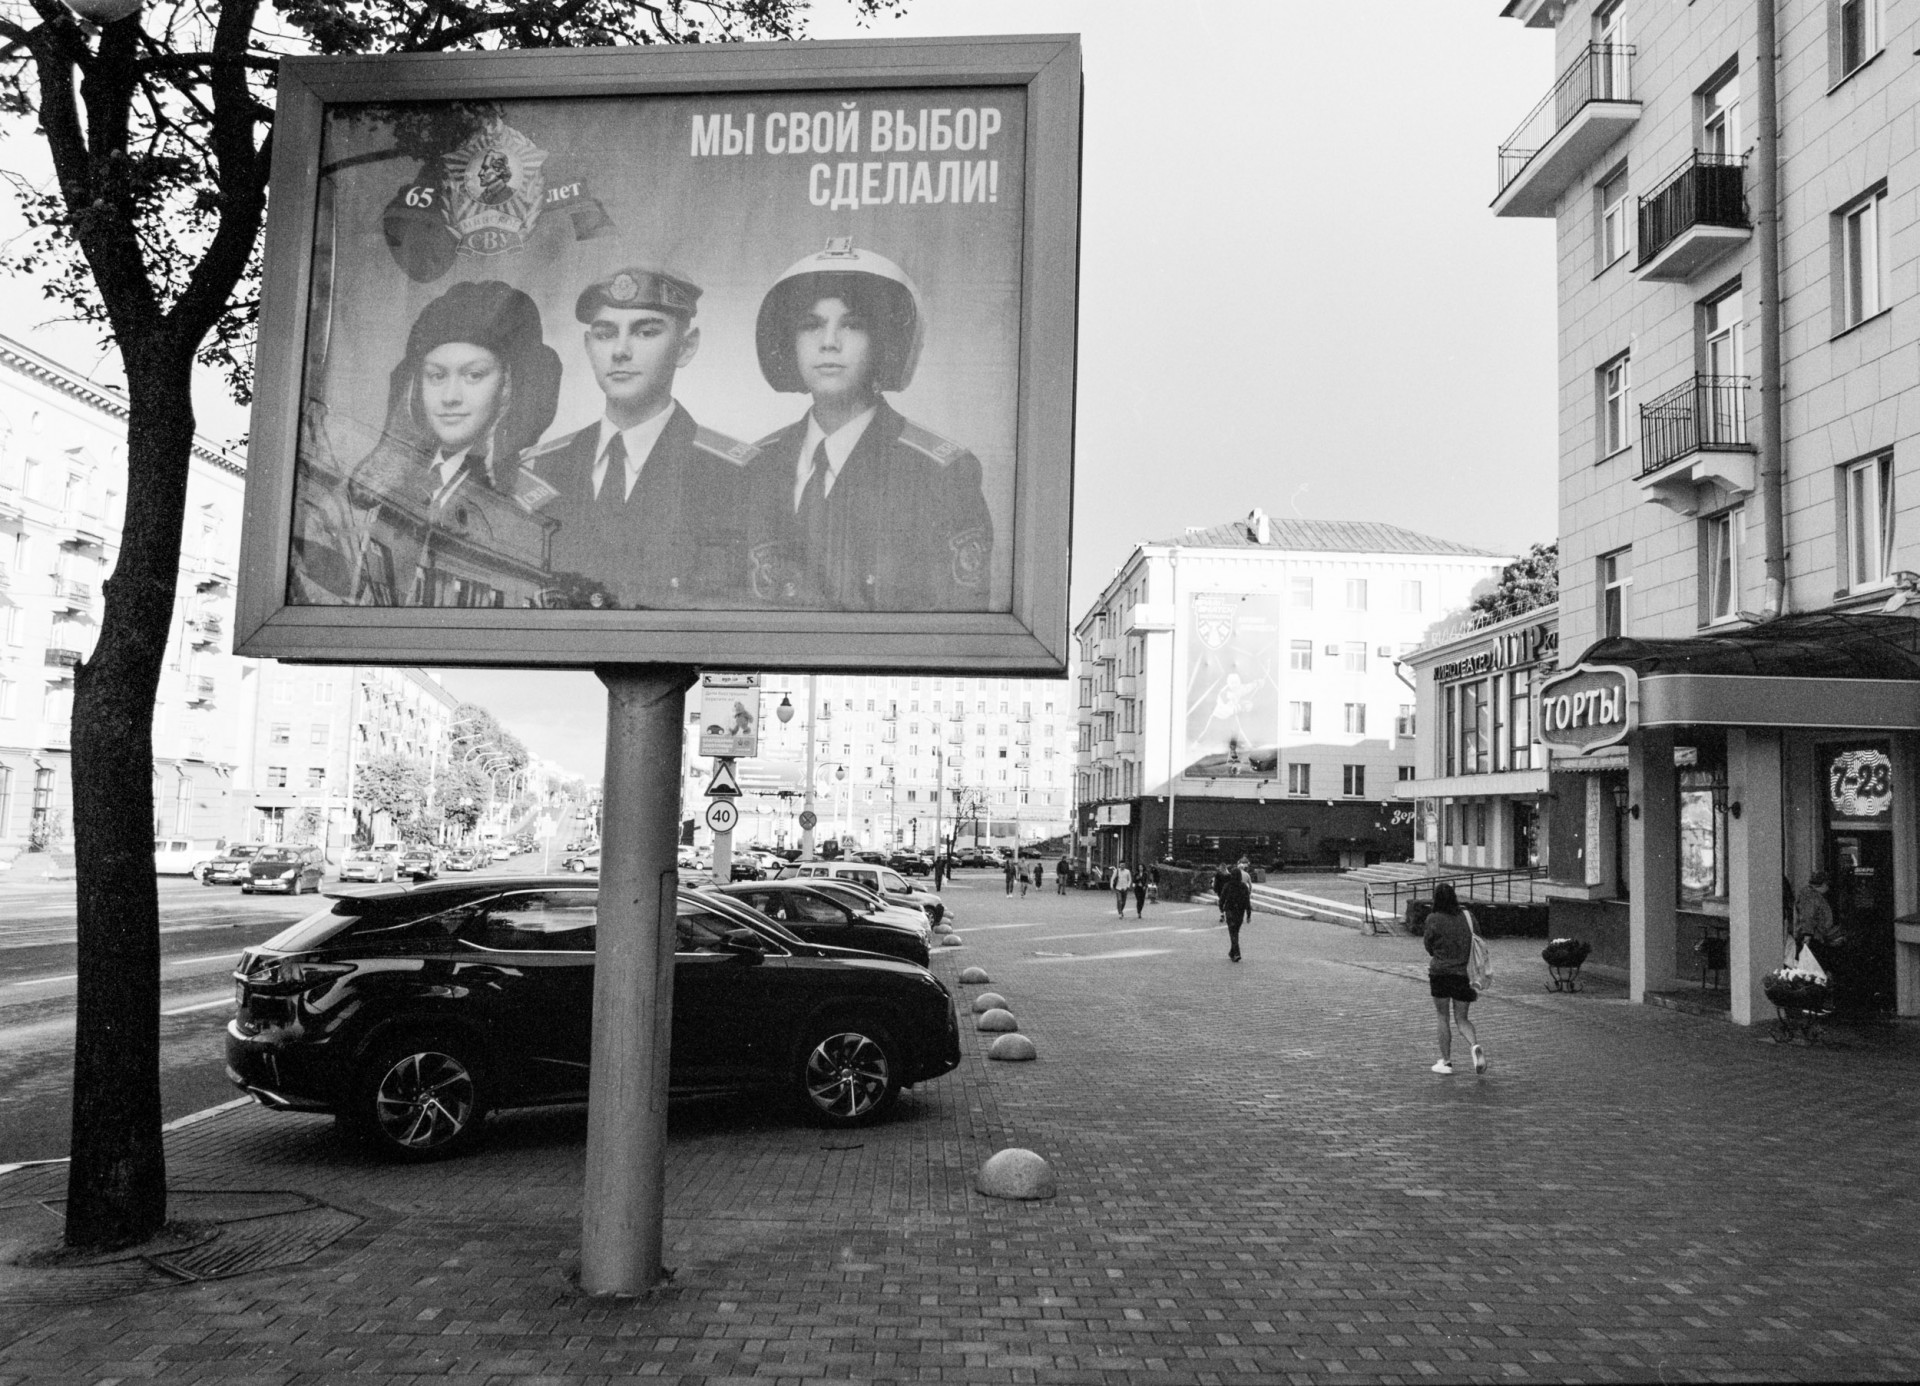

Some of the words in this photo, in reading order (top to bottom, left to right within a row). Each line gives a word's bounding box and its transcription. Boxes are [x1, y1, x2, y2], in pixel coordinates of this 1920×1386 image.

[691, 113, 755, 156] МЫ
[765, 102, 860, 154] СВОЙ
[871, 107, 1001, 152] ВЫБОР
[405, 186, 435, 208] 65
[546, 182, 581, 203] лет
[808, 160, 999, 211] СДЕЛАЛИ!
[1543, 685, 1621, 731] ТОРТЫ
[1832, 764, 1889, 798] 7-23
[712, 810, 730, 823] 40
